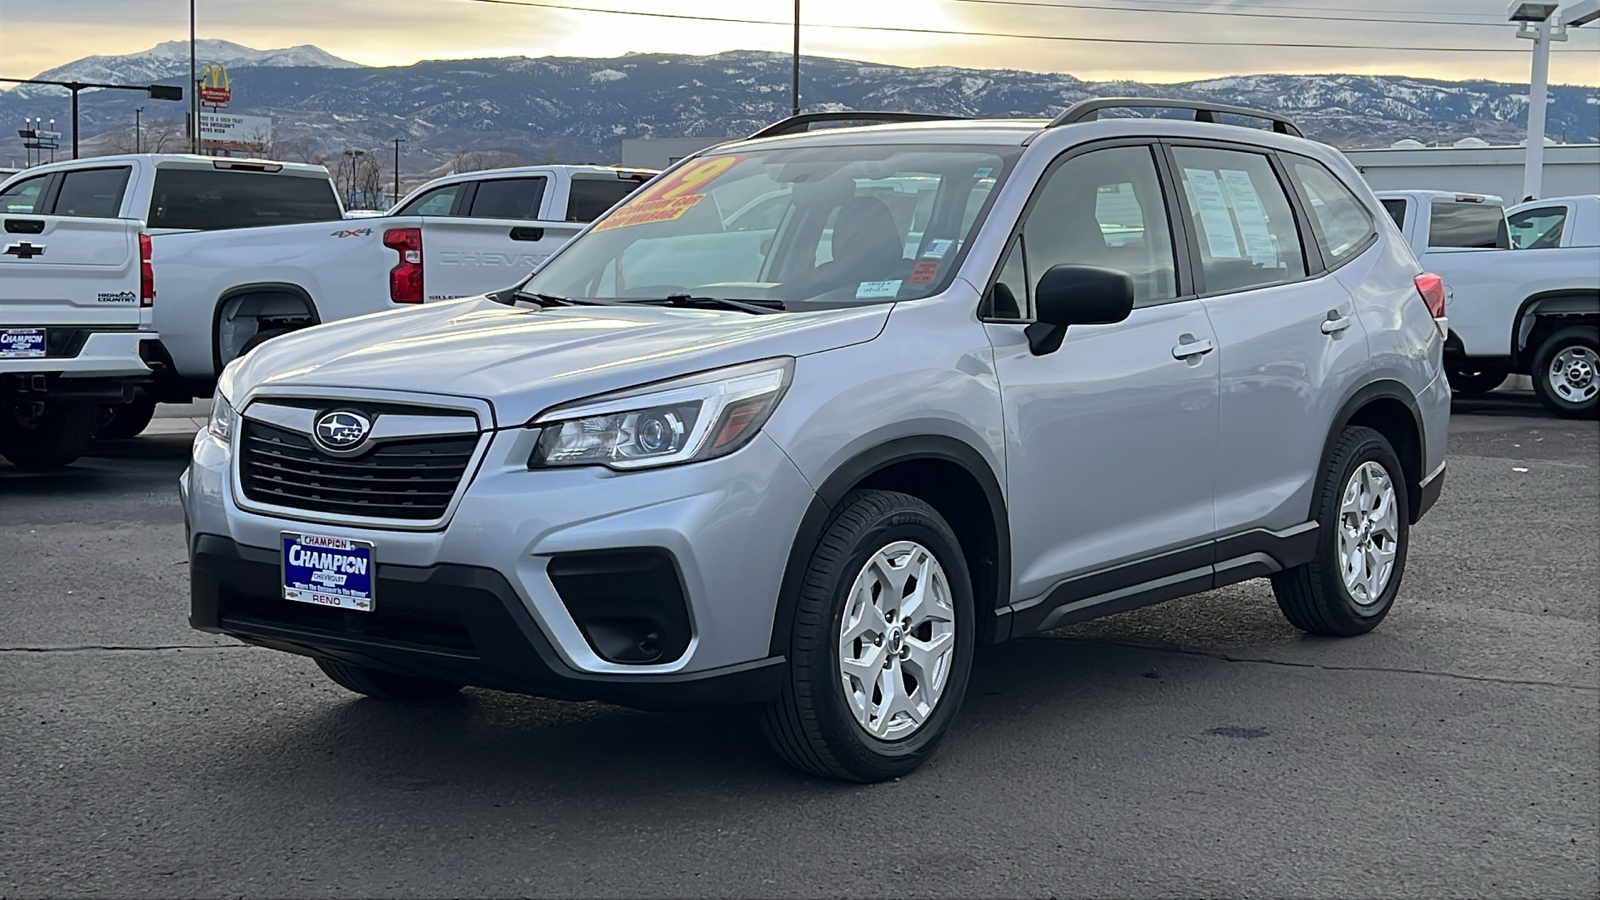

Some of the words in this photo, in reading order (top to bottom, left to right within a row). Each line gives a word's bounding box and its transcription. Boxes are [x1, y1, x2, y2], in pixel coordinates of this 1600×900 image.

[633, 157, 736, 206] 19
[440, 252, 550, 266] CHEVR
[1, 334, 43, 343] CHAMPION
[305, 536, 346, 548] CHAMPION
[289, 545, 367, 575] CHAMPION
[314, 573, 344, 582] CHEVROLET
[313, 595, 340, 605] RENO
